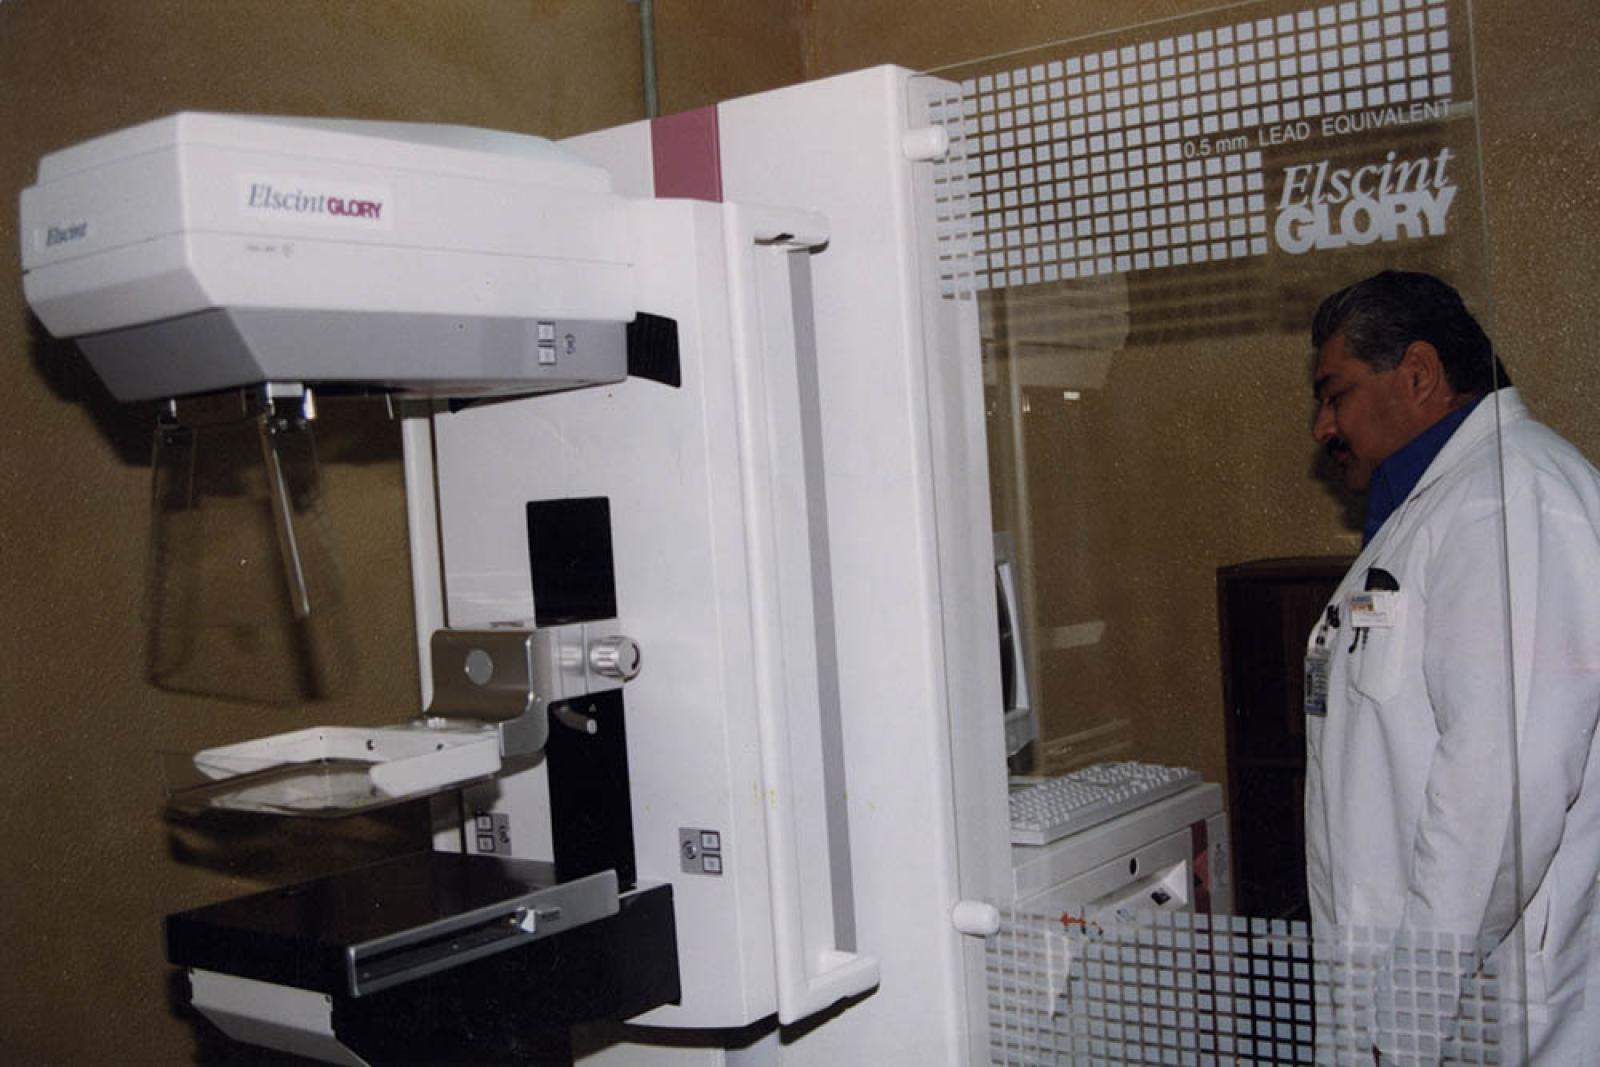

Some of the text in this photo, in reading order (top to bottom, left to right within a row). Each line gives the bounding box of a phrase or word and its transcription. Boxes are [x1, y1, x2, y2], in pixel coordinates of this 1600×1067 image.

[1183, 98, 1452, 158] 0.5 mm LEAD EQUIVALENT
[247, 183, 383, 219] Elscint GLORY
[1277, 146, 1457, 211] Elscint
[1274, 186, 1458, 255] GLORY
